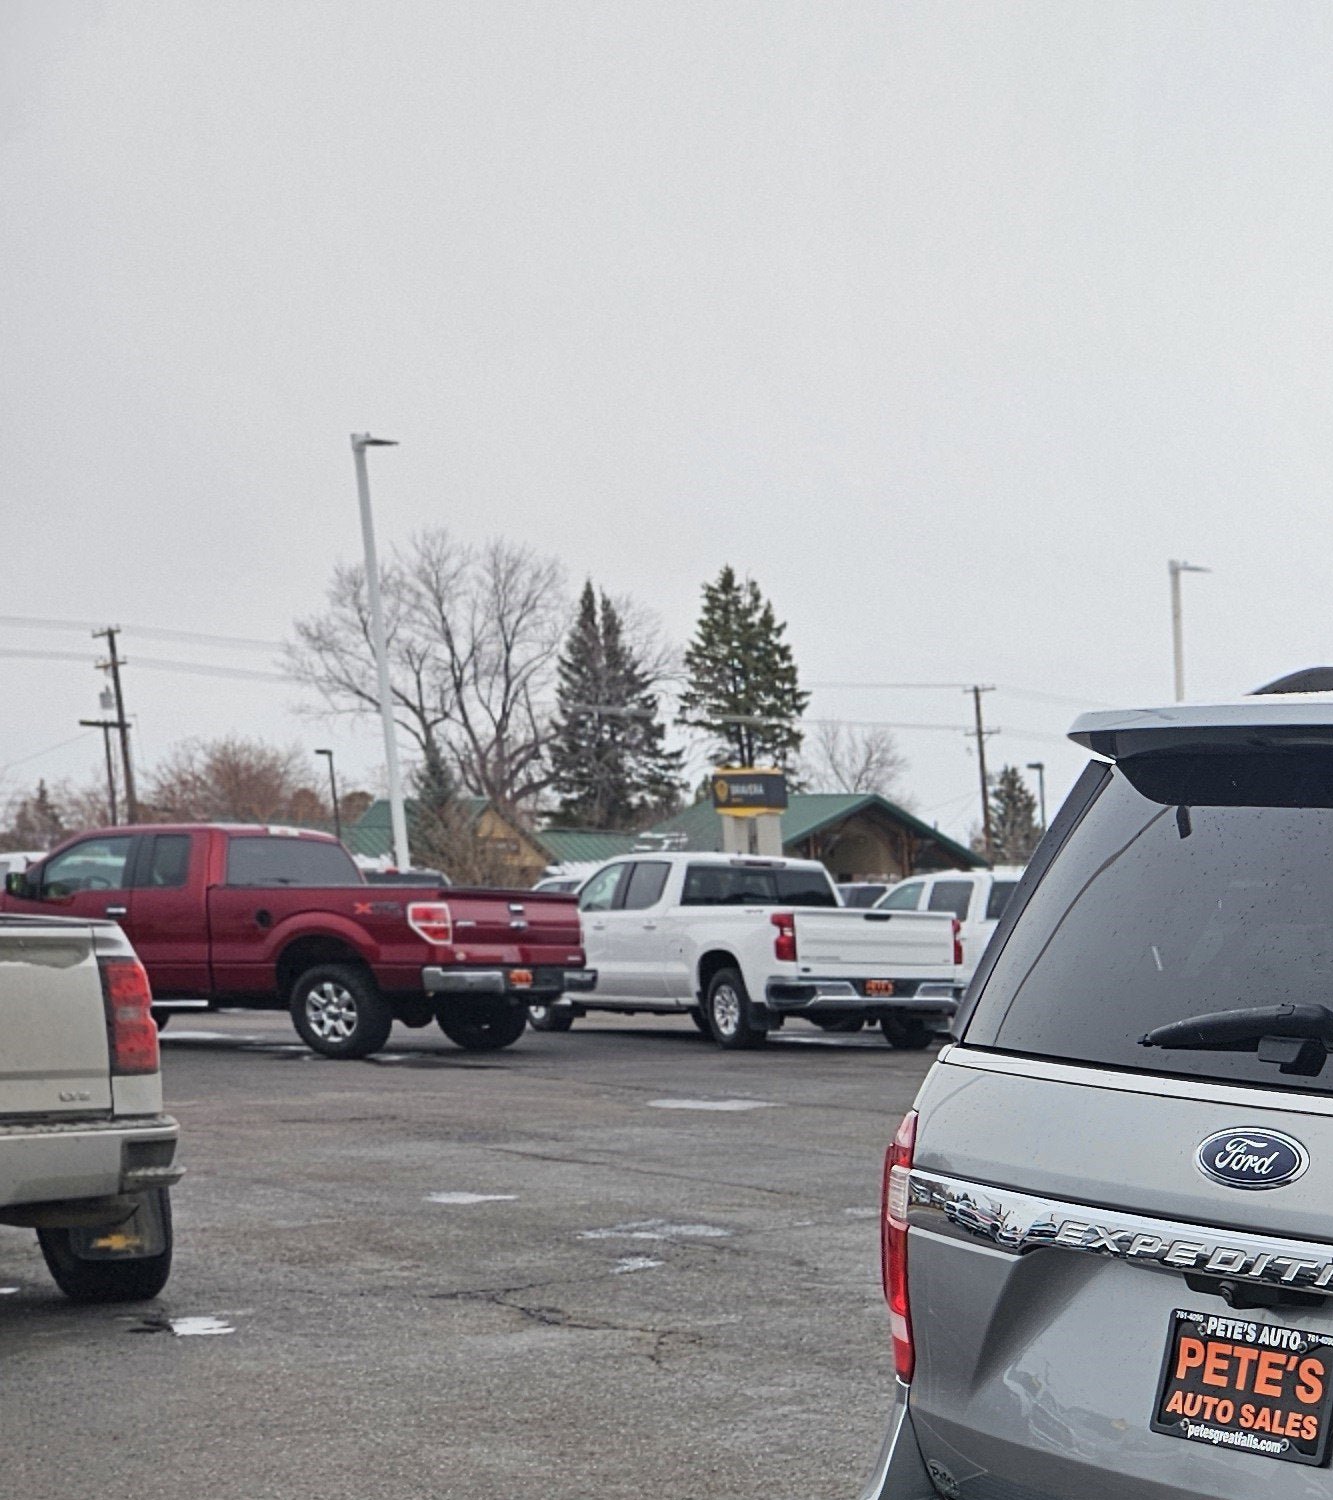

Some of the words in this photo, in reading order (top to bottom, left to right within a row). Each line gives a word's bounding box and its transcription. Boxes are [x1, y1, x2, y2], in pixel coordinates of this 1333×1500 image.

[1215, 1137, 1280, 1175] Ford
[1206, 1316, 1257, 1344] PETE'S
[1257, 1326, 1301, 1351] AUTO
[1175, 1337, 1325, 1404] PETE'S
[1165, 1390, 1235, 1424] AUTO
[1239, 1403, 1318, 1441] SALES
[1187, 1424, 1283, 1454] petesgreatfalls.com
